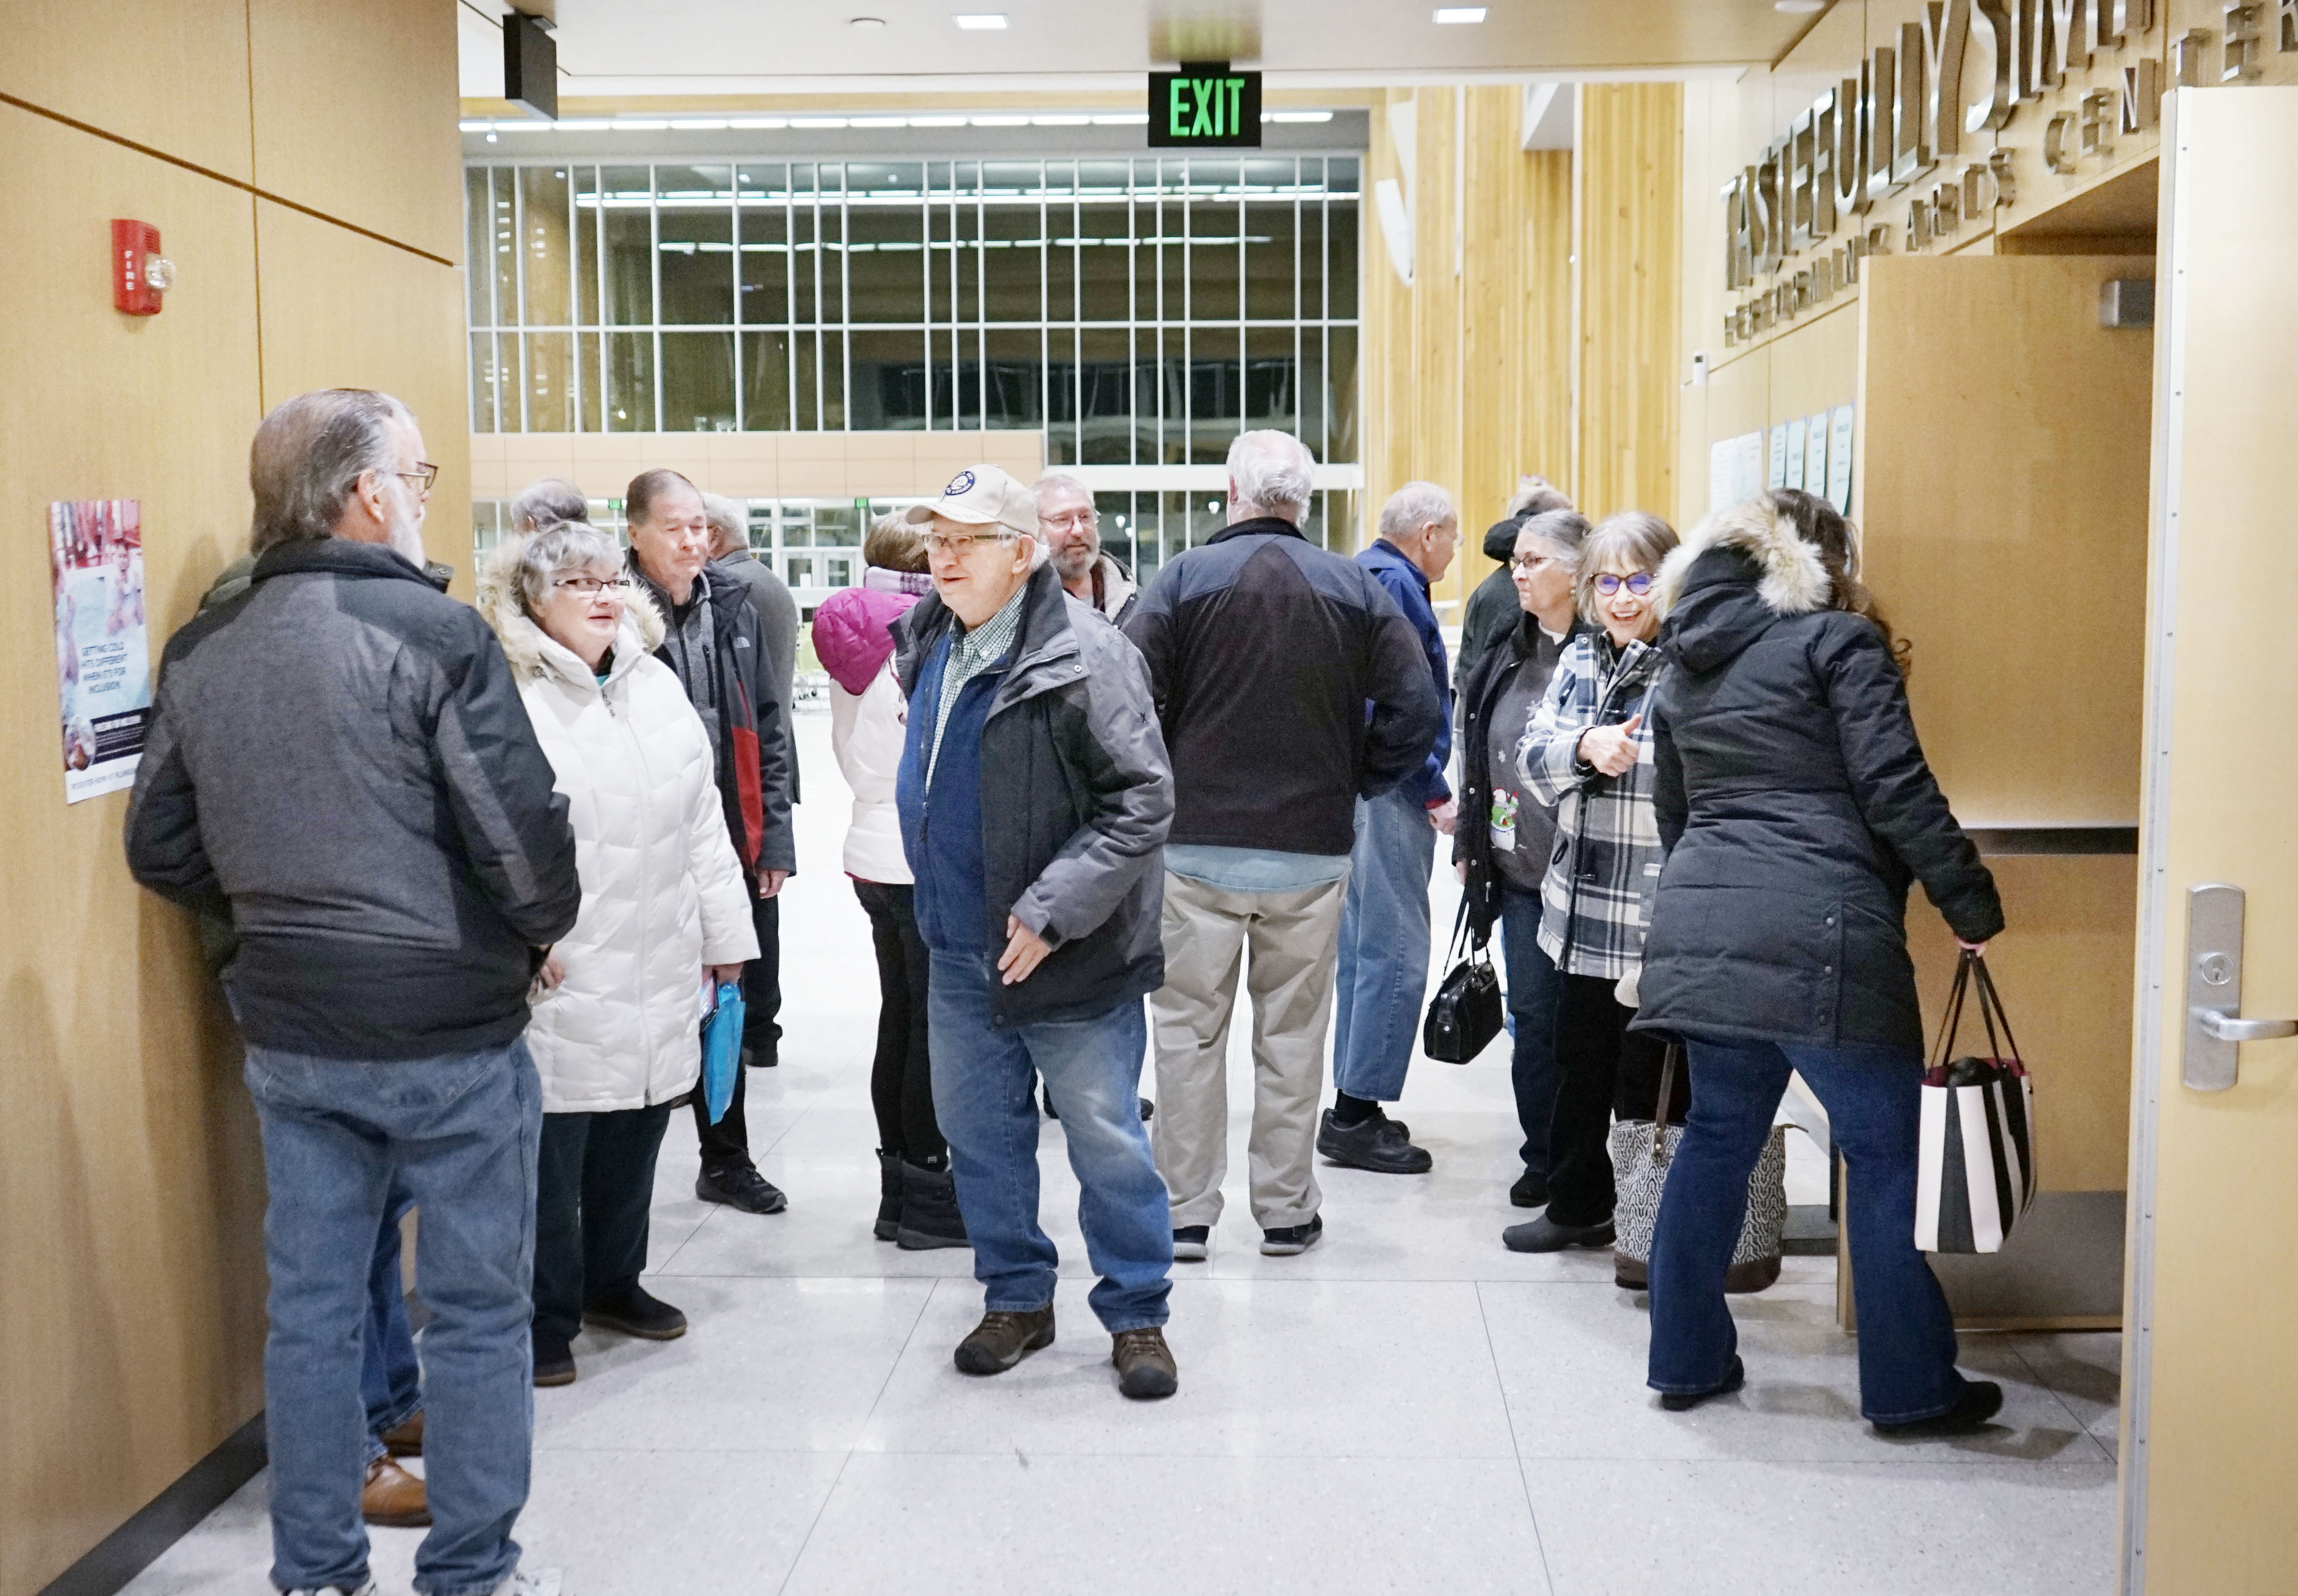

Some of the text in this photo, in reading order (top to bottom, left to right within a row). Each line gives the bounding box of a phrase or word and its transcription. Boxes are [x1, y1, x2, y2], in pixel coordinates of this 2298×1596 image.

[1170, 78, 1245, 136] EXIT
[1720, 0, 2153, 290] TASTEFULLY SIM
[125, 250, 135, 290] FIRE
